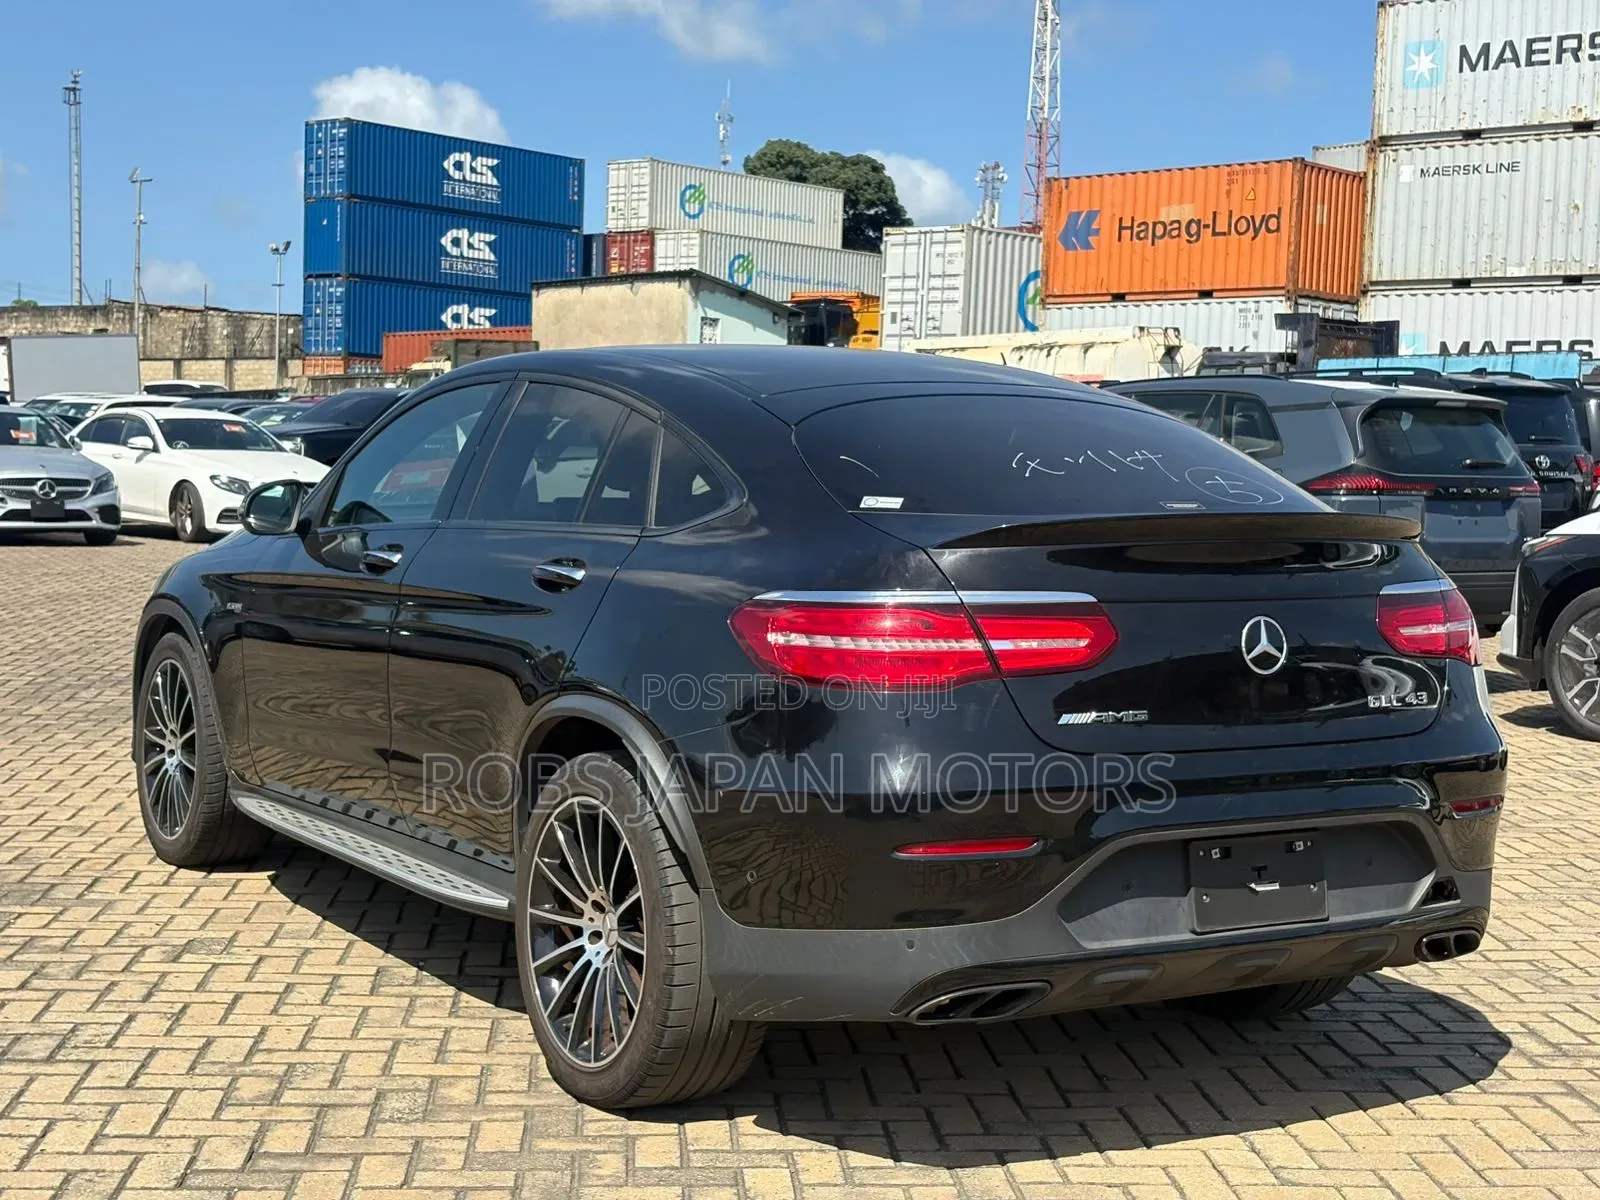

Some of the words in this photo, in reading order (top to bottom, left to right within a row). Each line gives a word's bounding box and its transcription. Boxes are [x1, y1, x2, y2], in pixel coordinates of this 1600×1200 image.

[1420, 164, 1482, 178] MAERSK
[1485, 161, 1521, 174] LINE
[1117, 207, 1282, 246] Hapag-Lloyd
[1405, 691, 1429, 705] 43
[1084, 710, 1148, 723] AMG
